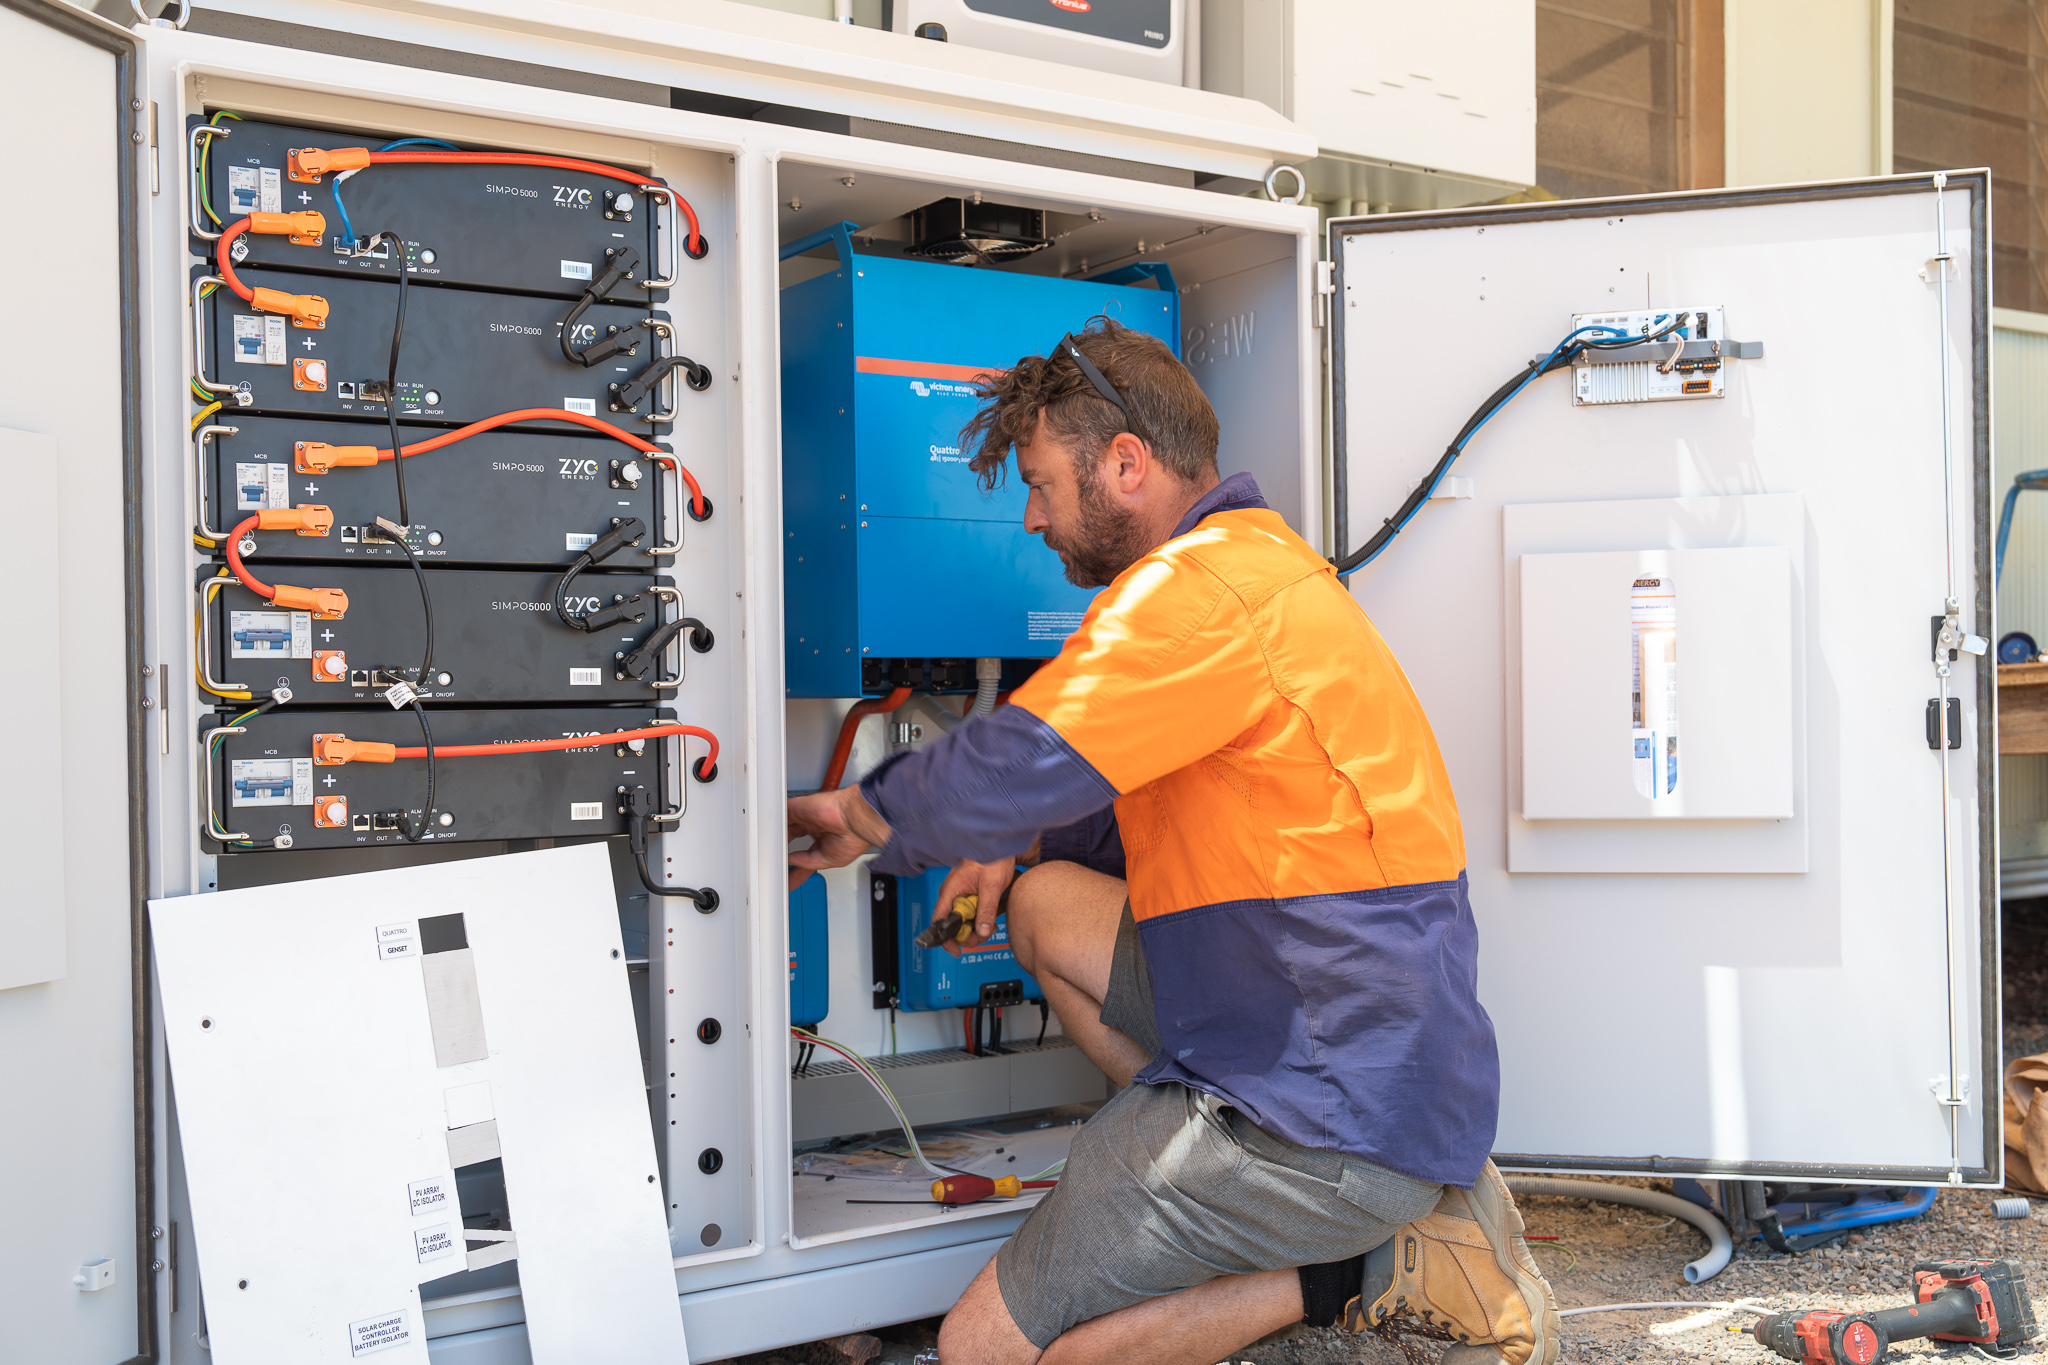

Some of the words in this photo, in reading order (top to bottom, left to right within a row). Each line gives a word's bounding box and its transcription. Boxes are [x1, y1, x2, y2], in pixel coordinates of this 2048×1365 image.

[1052, 0, 1088, 10] ronius
[1144, 30, 1164, 40] PRIMO
[552, 186, 592, 204] ZYC
[556, 202, 588, 210] ENERGY
[929, 382, 954, 392] victron
[954, 386, 977, 396] energ
[930, 444, 960, 456] Quattro
[558, 458, 598, 476] ZYC
[382, 928, 408, 937] QUATTRO
[388, 946, 408, 954] GENSET
[424, 1186, 440, 1196] ARRAY
[412, 1199, 420, 1207] DC
[421, 1193, 446, 1206] ISOLATOR
[430, 1232, 446, 1242] ARRAY
[420, 1246, 428, 1254] DC
[428, 1240, 452, 1252] ISOLATOR
[358, 1324, 378, 1334] SOLAR
[378, 1317, 402, 1328] CHARGE
[362, 1326, 400, 1341] CONTROLLER
[354, 1338, 381, 1352] BATTERY
[380, 1332, 409, 1344] ISOLATOR
